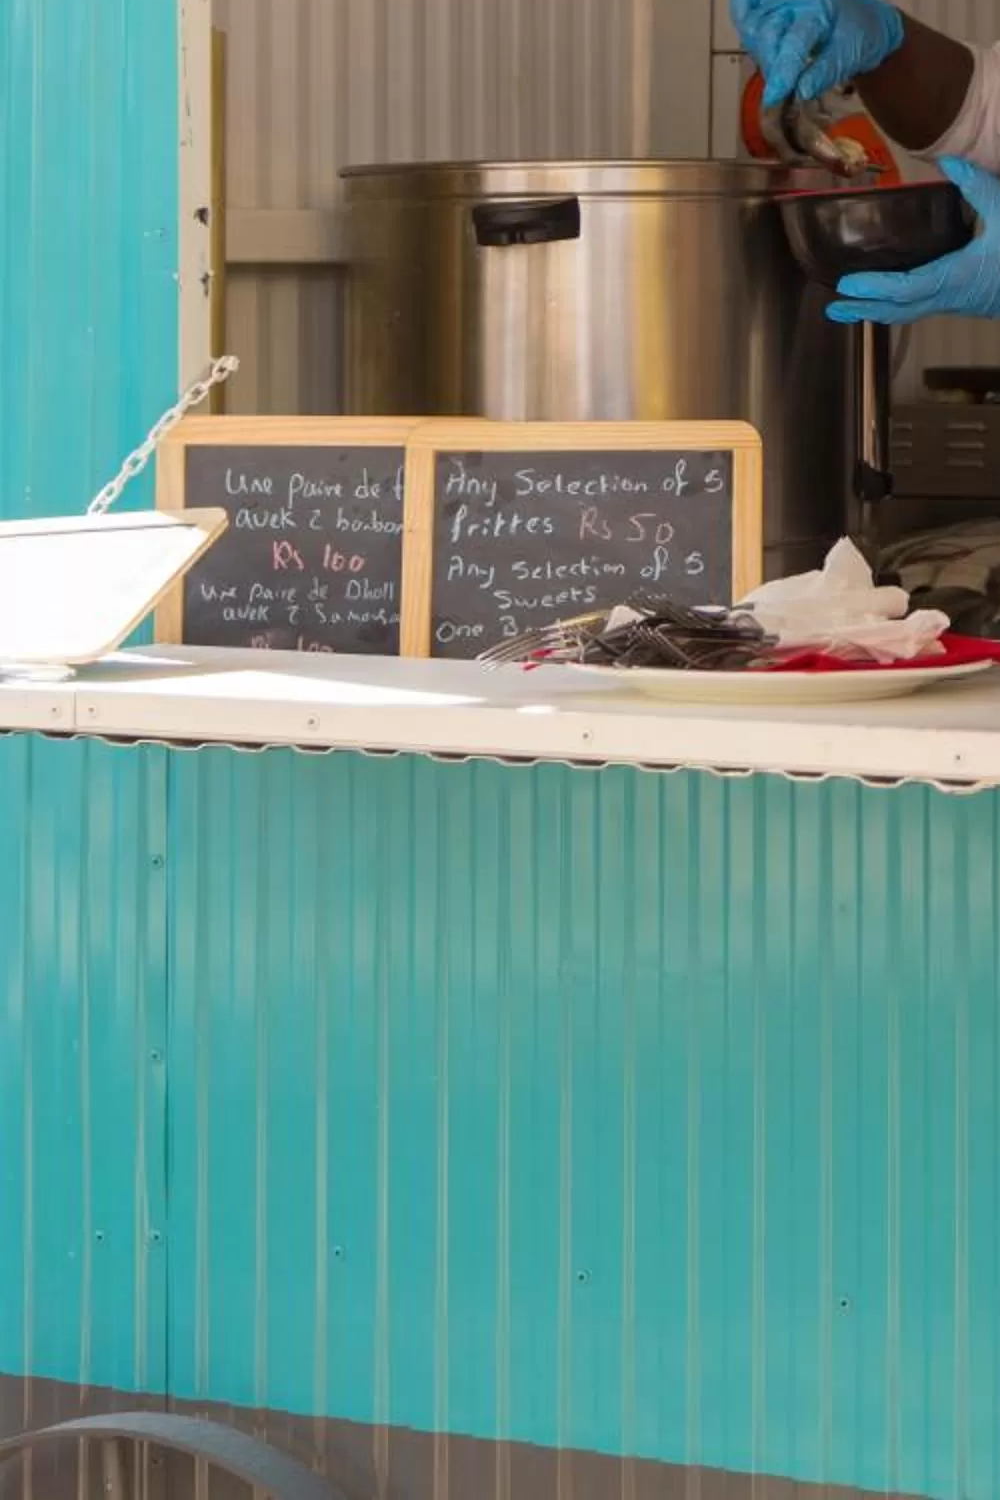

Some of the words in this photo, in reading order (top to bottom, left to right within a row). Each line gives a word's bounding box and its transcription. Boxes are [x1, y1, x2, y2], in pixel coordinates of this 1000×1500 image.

[225, 467, 273, 496] Une
[354, 467, 380, 499] de
[446, 460, 497, 507] Any
[663, 458, 688, 496] of
[704, 469, 724, 493] 5
[308, 509, 321, 531] 2
[579, 504, 612, 541] Rs
[625, 512, 675, 544] 50
[273, 540, 304, 570] Rs
[323, 543, 365, 573] 100
[449, 555, 495, 589] Any
[640, 546, 669, 581] of
[684, 551, 704, 575] 5
[308, 577, 329, 600] de
[493, 585, 597, 610] Sweets
[436, 620, 484, 642] One
